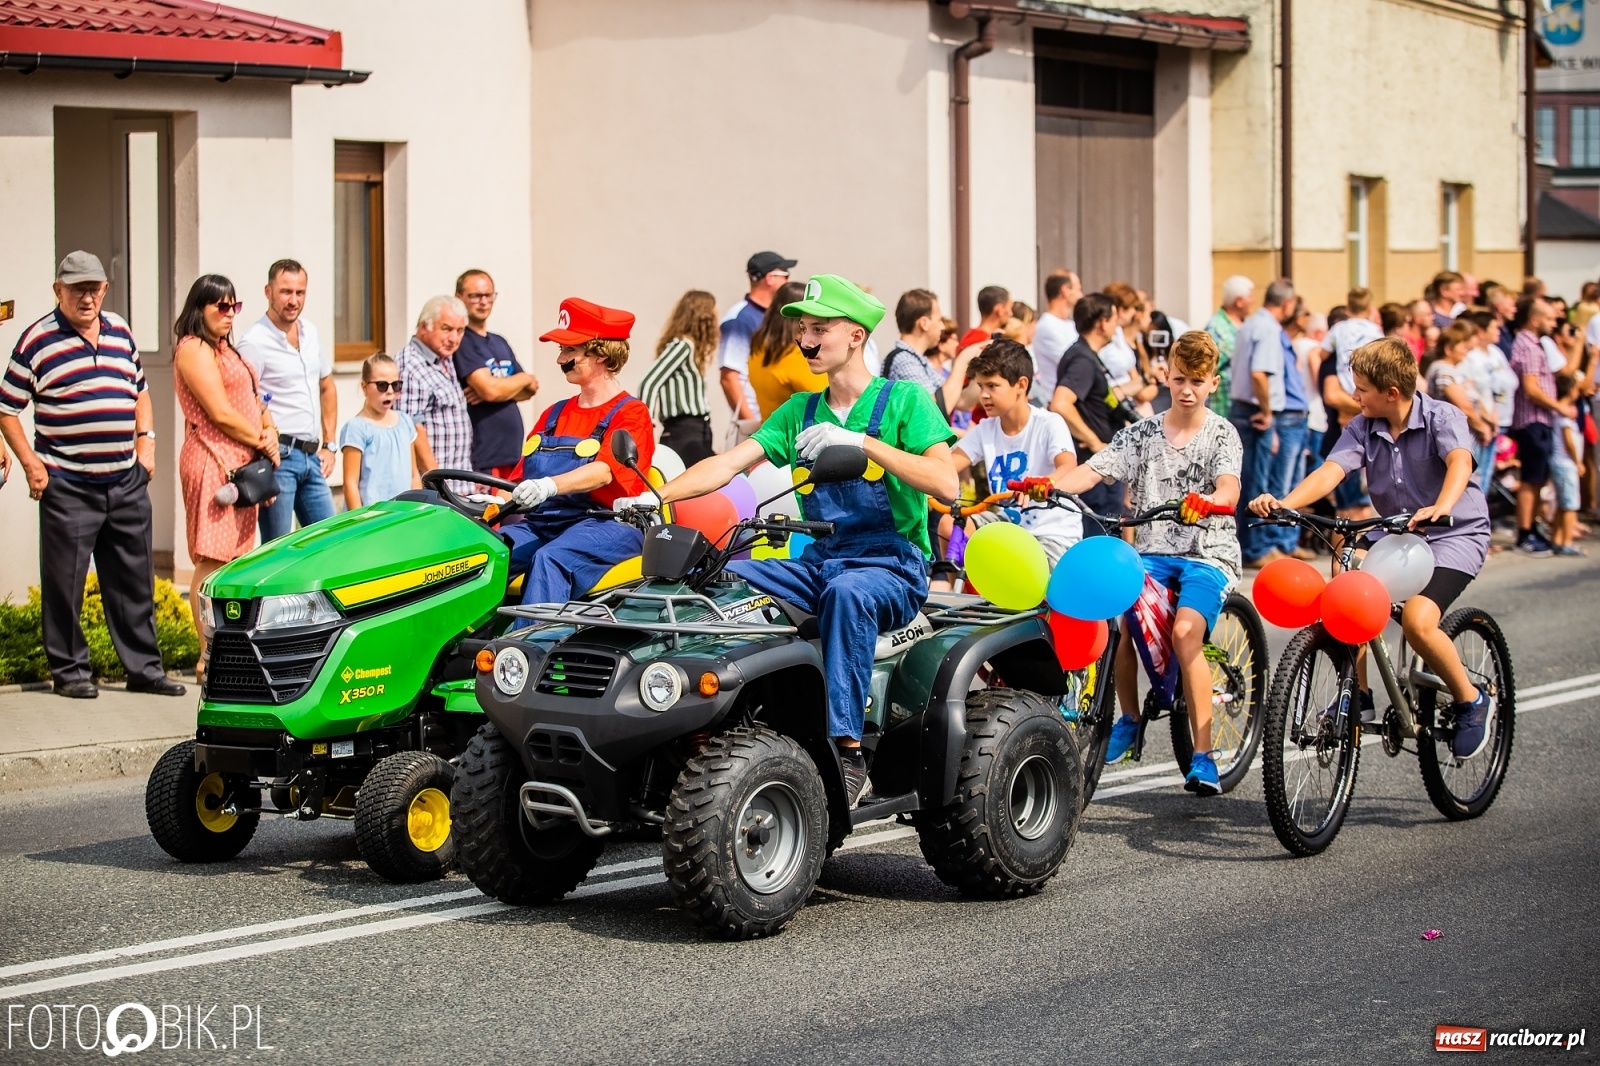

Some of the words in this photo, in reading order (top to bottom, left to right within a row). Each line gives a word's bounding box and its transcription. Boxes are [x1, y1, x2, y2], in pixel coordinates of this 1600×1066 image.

[805, 283, 815, 301] L
[557, 312, 568, 326] M
[422, 569, 444, 584] JOHN
[445, 560, 470, 576] DEERE
[891, 625, 925, 647] AEON
[355, 664, 392, 680] Chempest
[339, 685, 376, 705] X350
[376, 684, 385, 695] R
